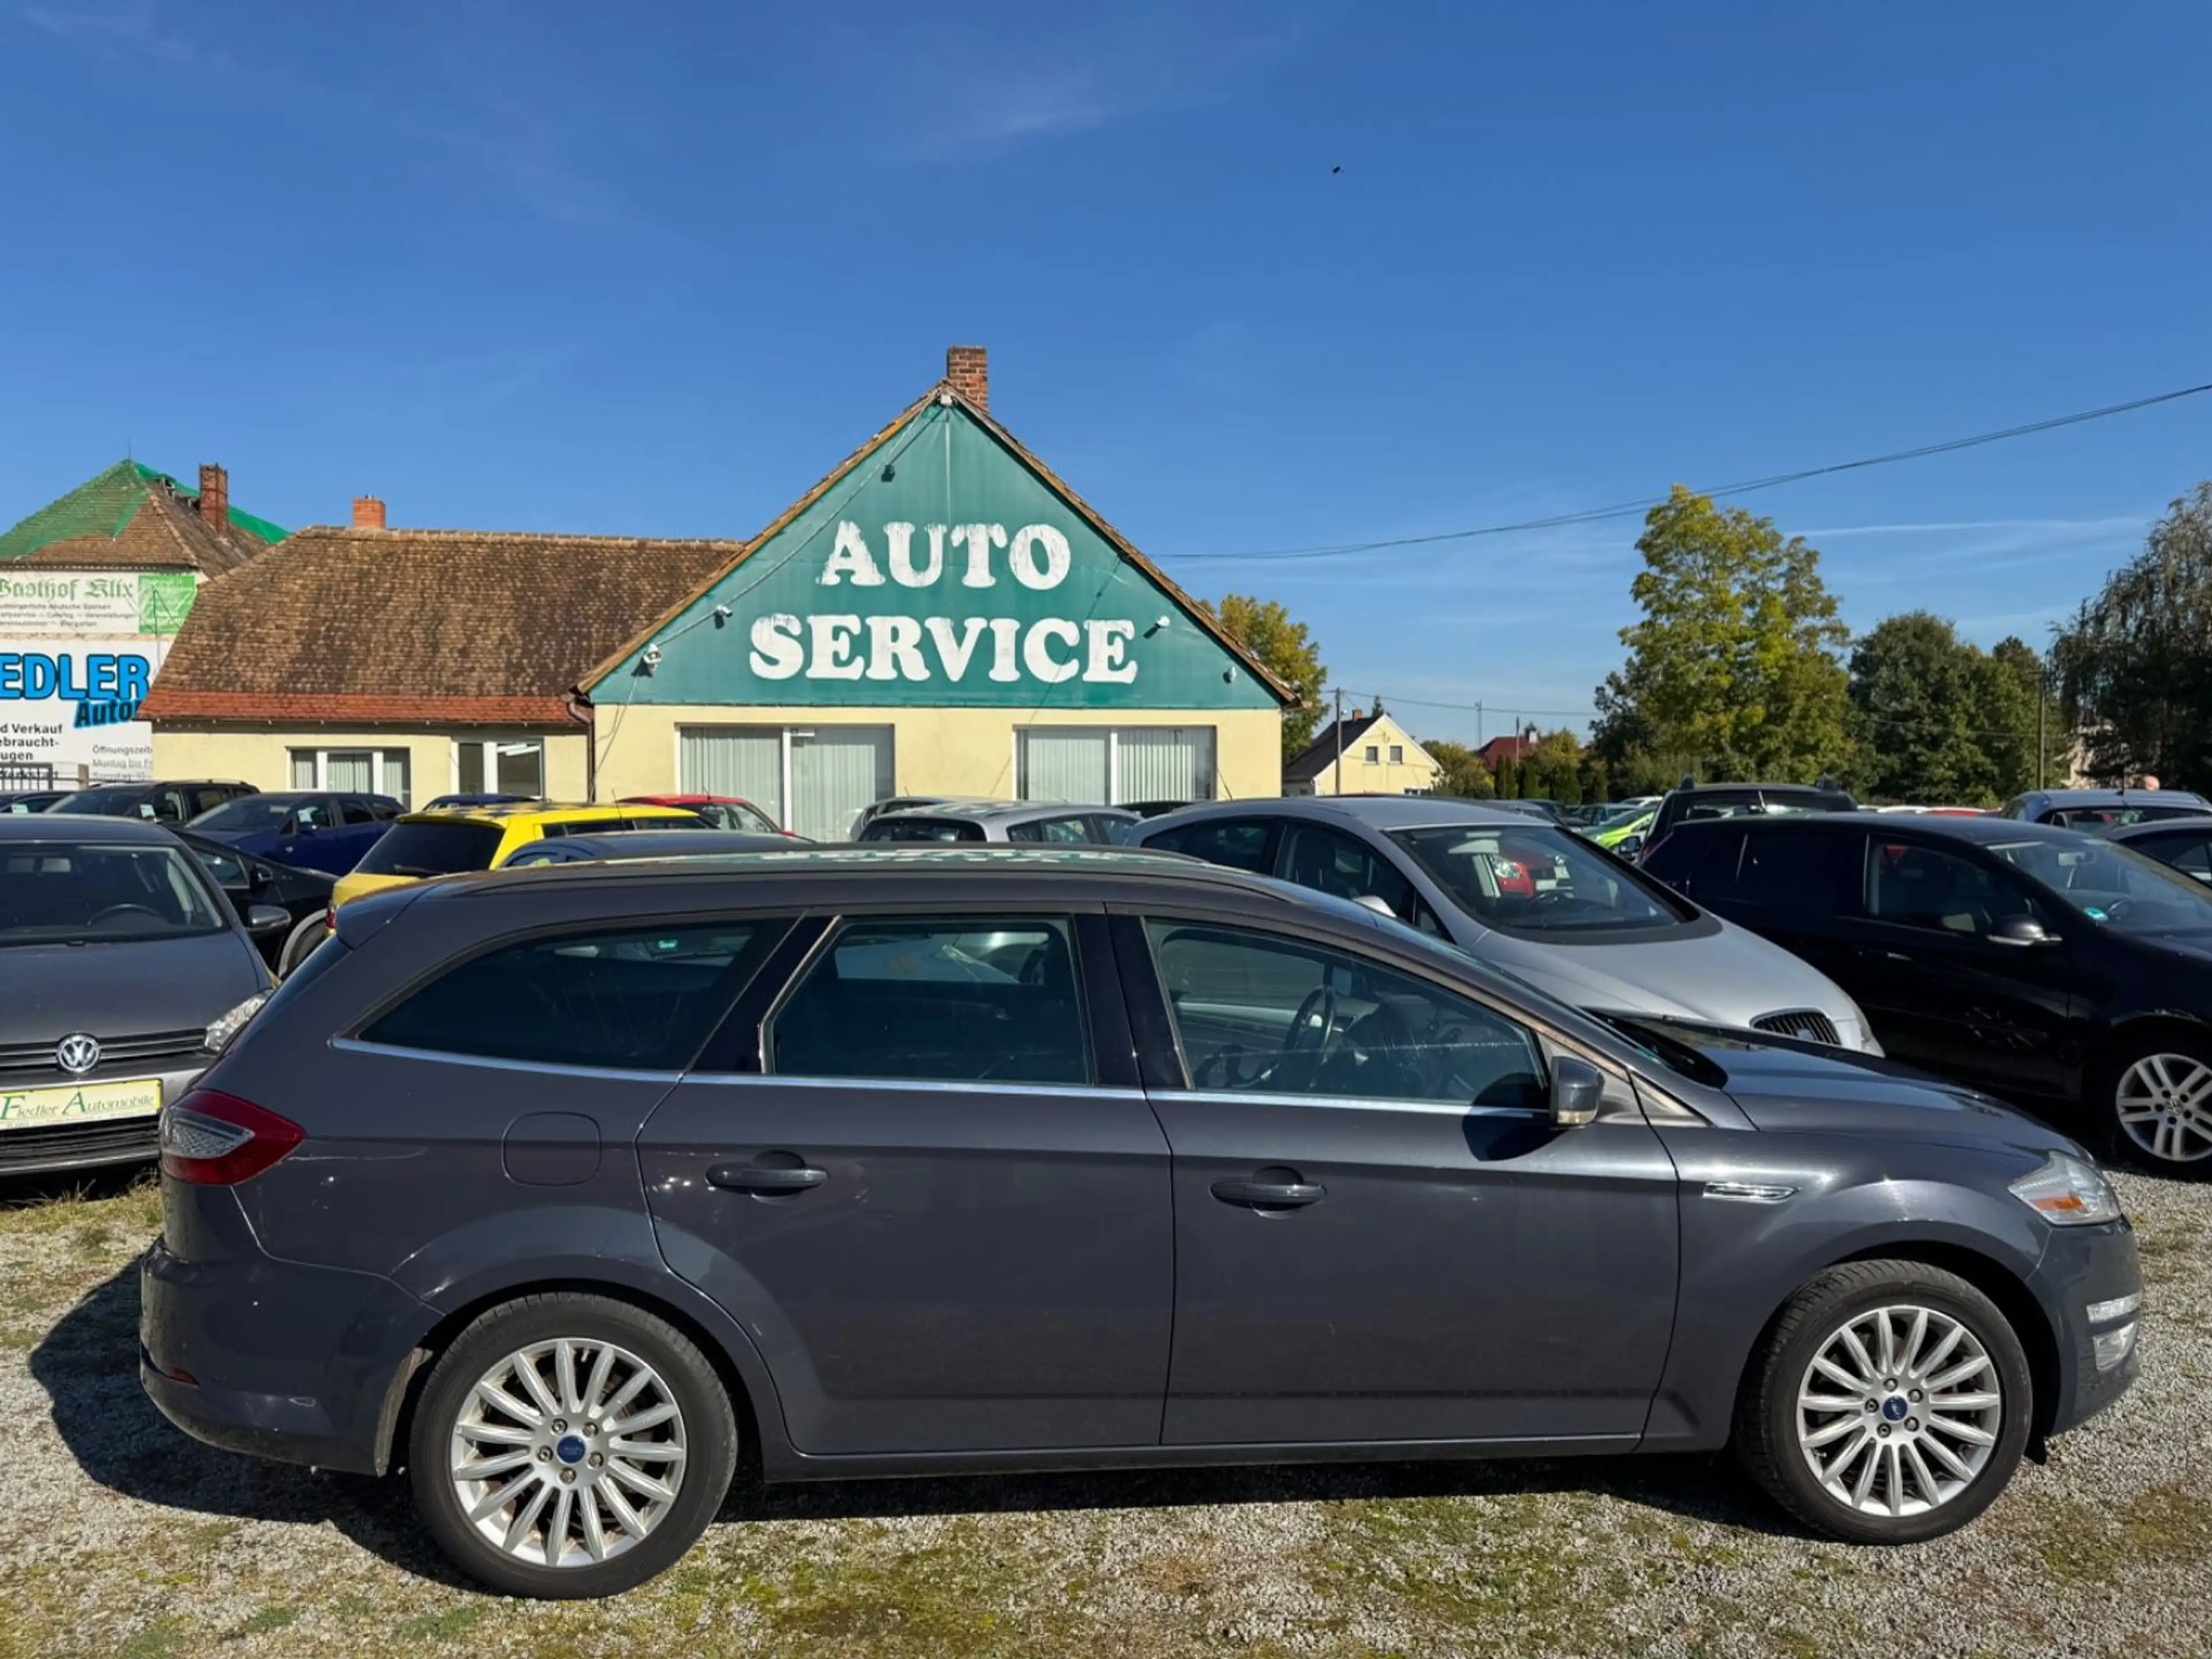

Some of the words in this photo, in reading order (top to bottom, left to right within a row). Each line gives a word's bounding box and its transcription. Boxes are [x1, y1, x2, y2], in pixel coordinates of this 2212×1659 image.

[816, 521, 1071, 590] AUTO
[749, 613, 1138, 684] SERVICE
[12, 724, 62, 734] Verkauf
[62, 1090, 154, 1113] Automobile
